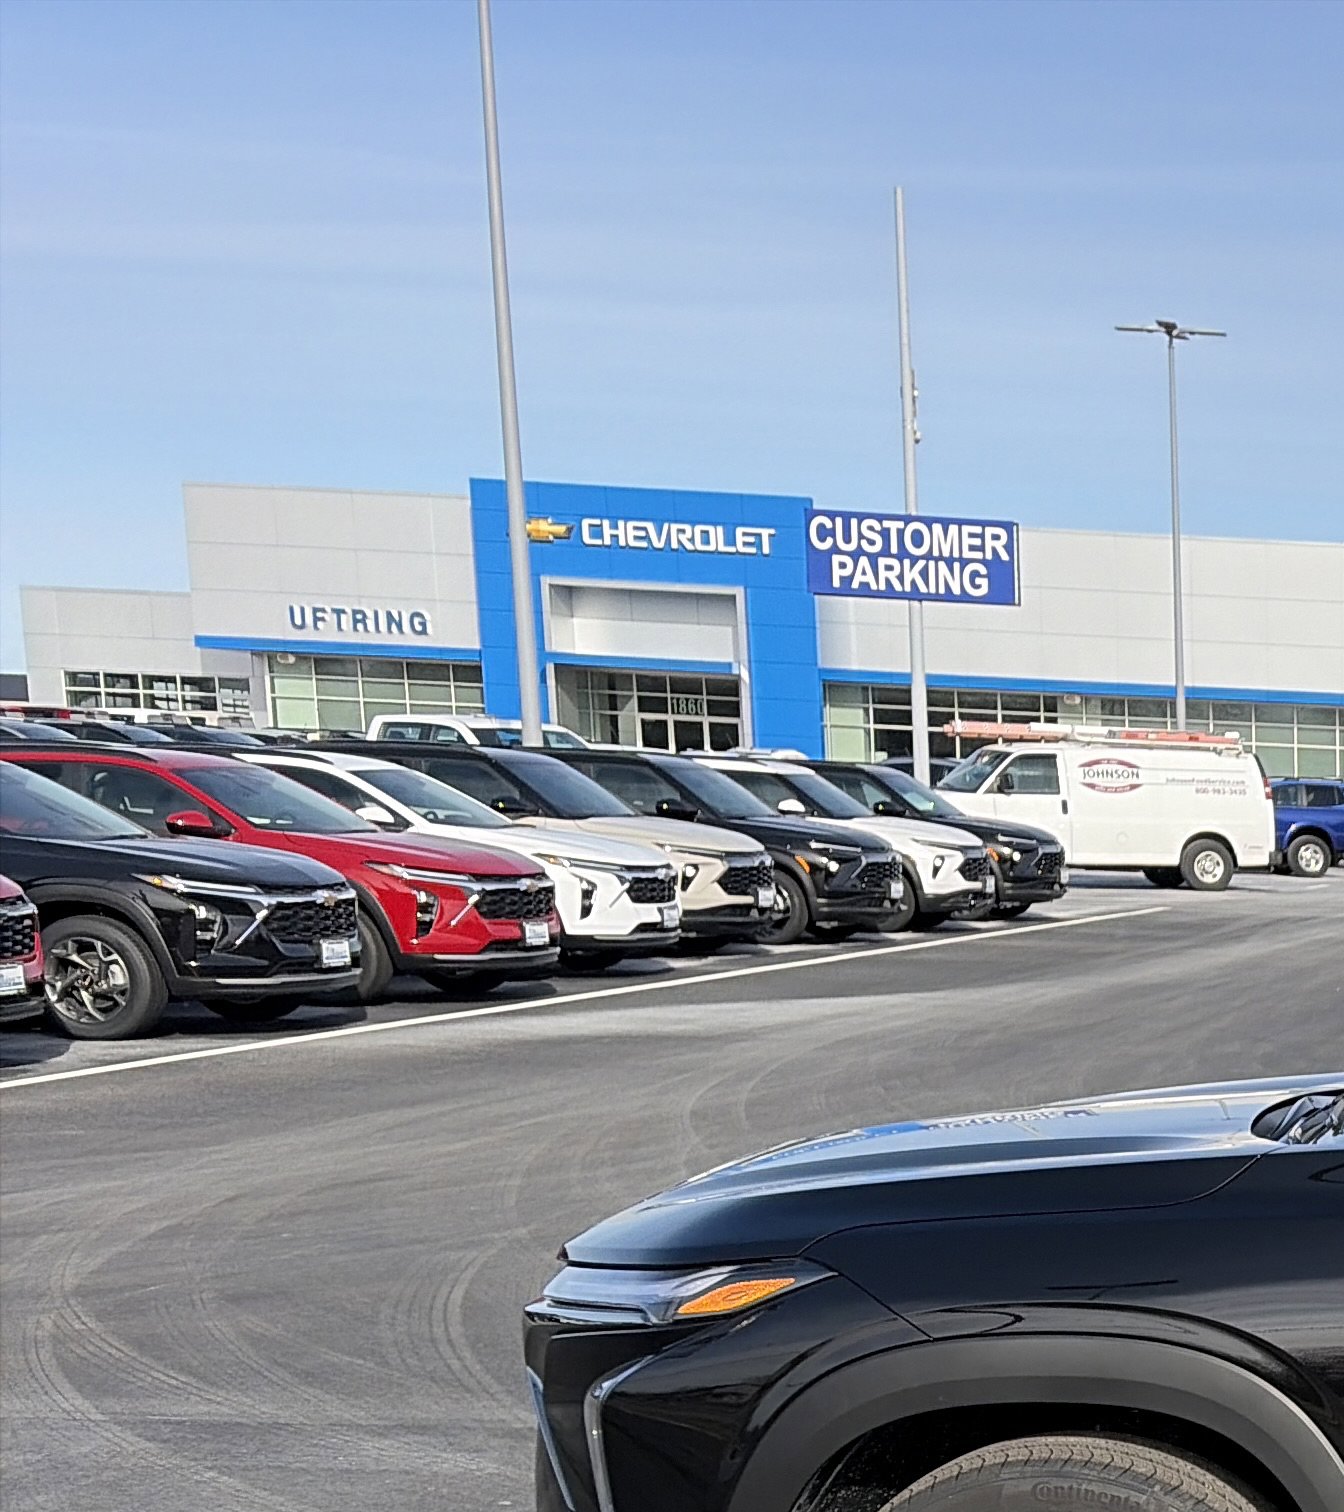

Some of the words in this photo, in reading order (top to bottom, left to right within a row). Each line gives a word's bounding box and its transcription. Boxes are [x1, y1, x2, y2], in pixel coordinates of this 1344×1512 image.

[580, 517, 777, 557] CHEVROLET
[808, 514, 1011, 562] CUSTOMER
[830, 553, 990, 598] PARKING
[288, 603, 430, 636] UFTRING
[671, 697, 705, 715] 1860
[1082, 768, 1141, 780] JOHNSON
